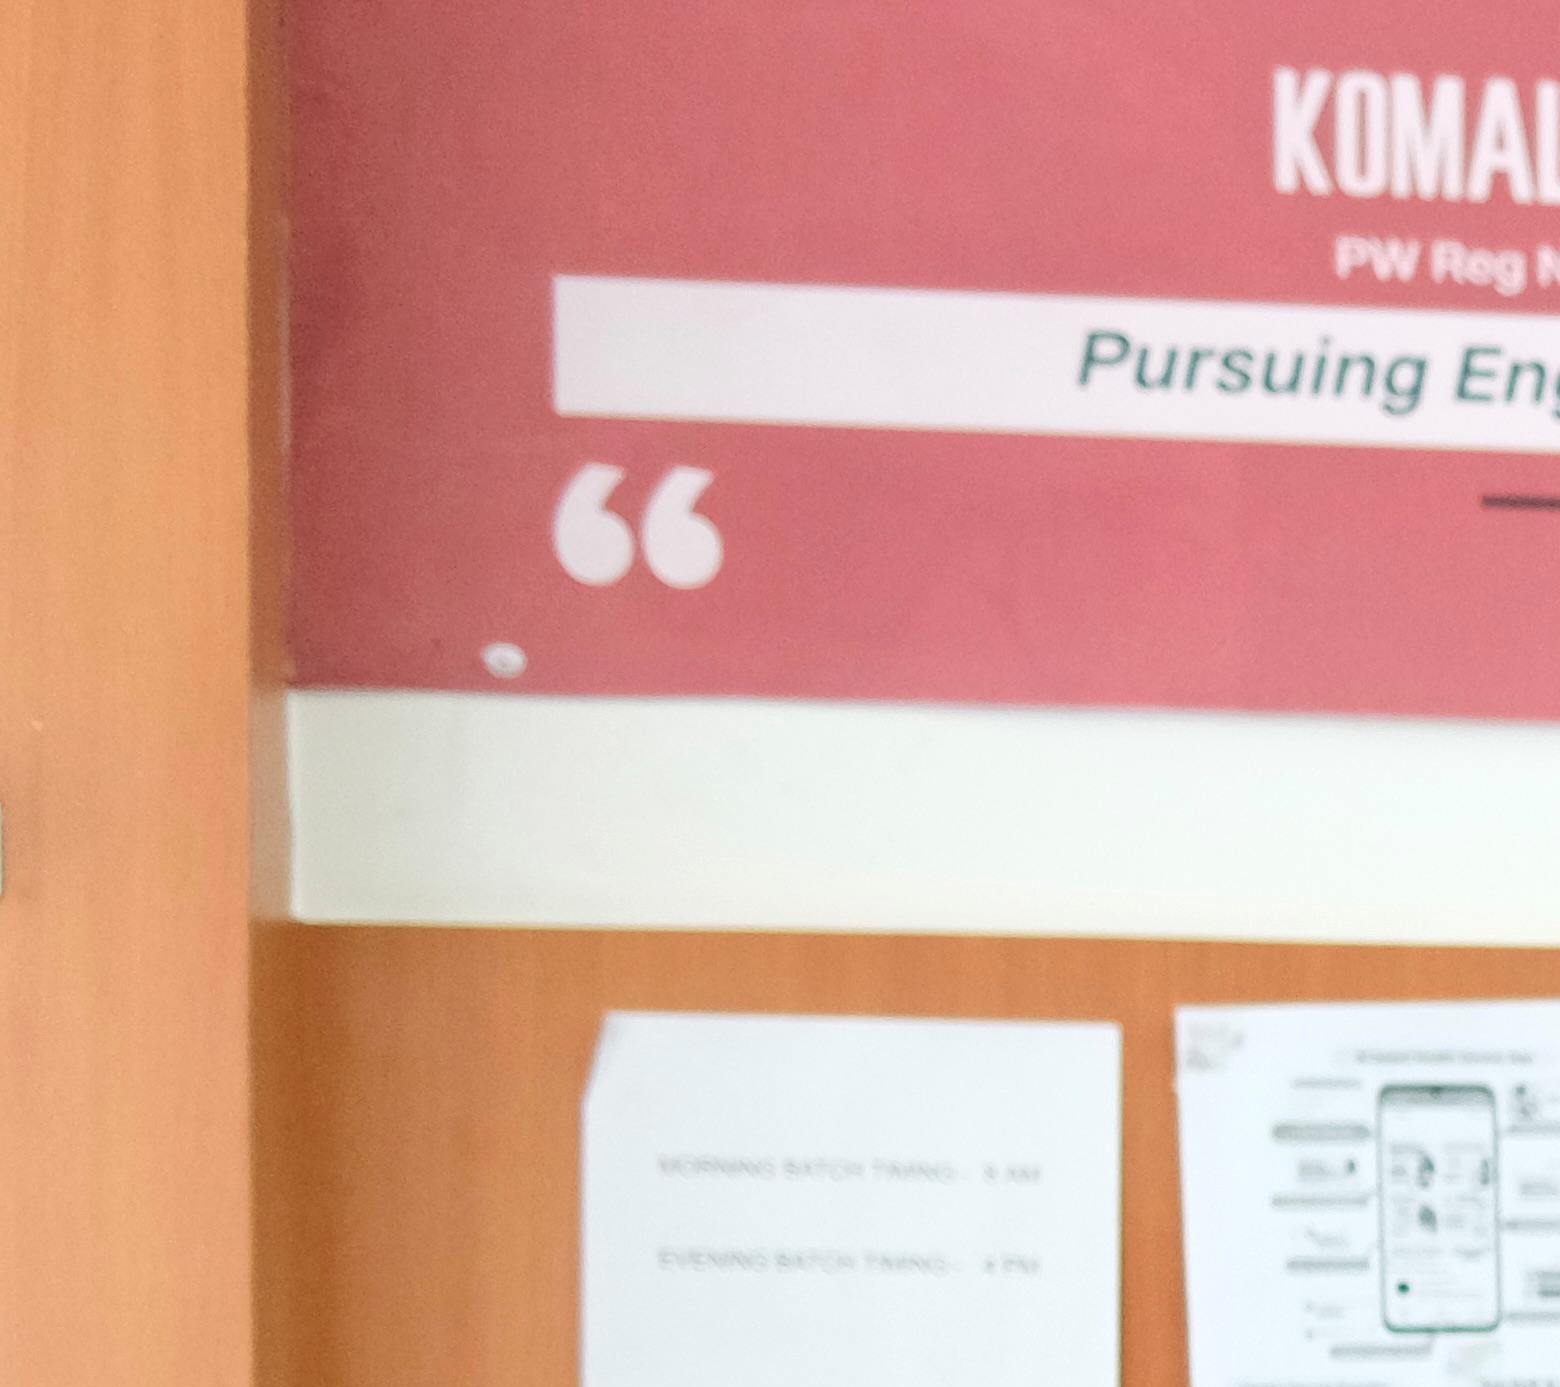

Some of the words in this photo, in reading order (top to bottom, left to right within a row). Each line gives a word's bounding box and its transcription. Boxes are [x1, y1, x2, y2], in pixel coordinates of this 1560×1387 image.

[1333, 235, 1420, 283] PW
[1428, 238, 1527, 297] Reg
[1075, 328, 1429, 416] Pursuing
